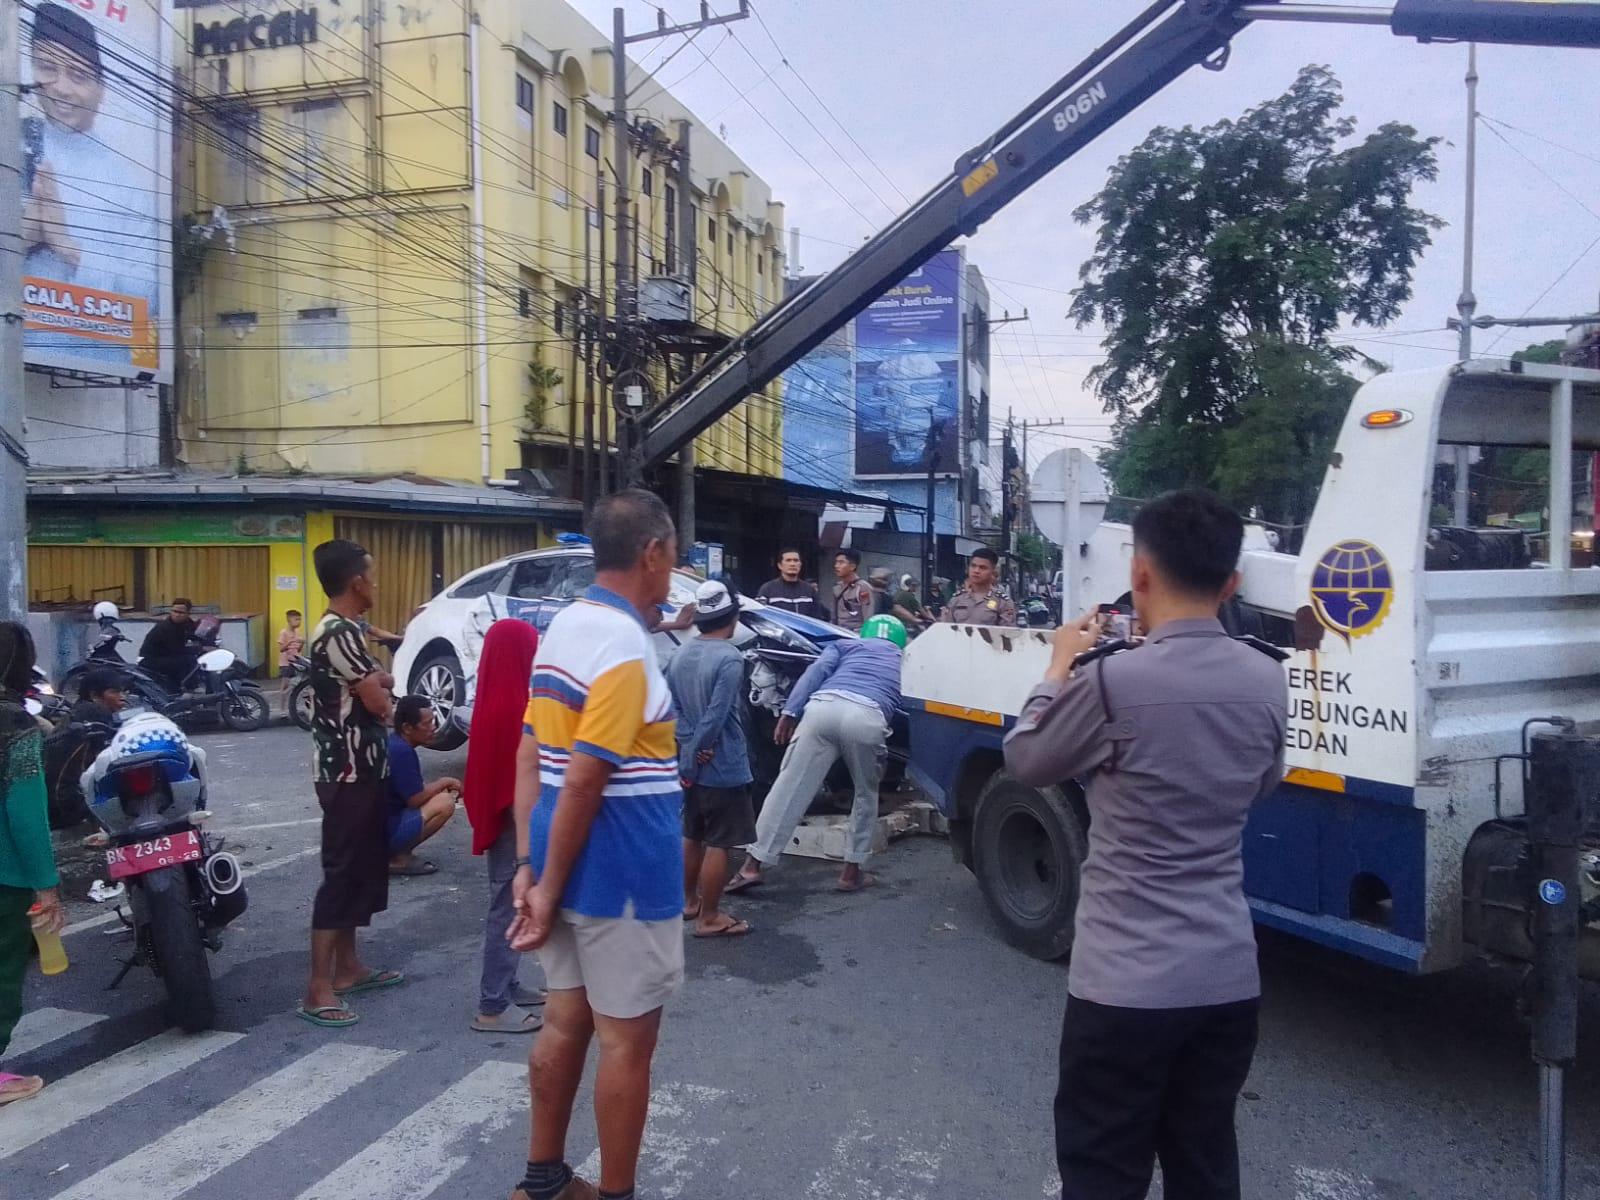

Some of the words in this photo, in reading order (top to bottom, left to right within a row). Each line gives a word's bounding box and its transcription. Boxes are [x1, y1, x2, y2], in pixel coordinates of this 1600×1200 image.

[1053, 81, 1107, 132] 806N
[901, 297, 922, 307] Judi
[923, 295, 954, 306] Online
[1288, 667, 1352, 695] EREK
[1286, 698, 1408, 734] UBUNGAN
[1284, 727, 1347, 757] EDAN
[105, 849, 127, 866] BK
[134, 837, 172, 858] 2343
[187, 830, 199, 845] A
